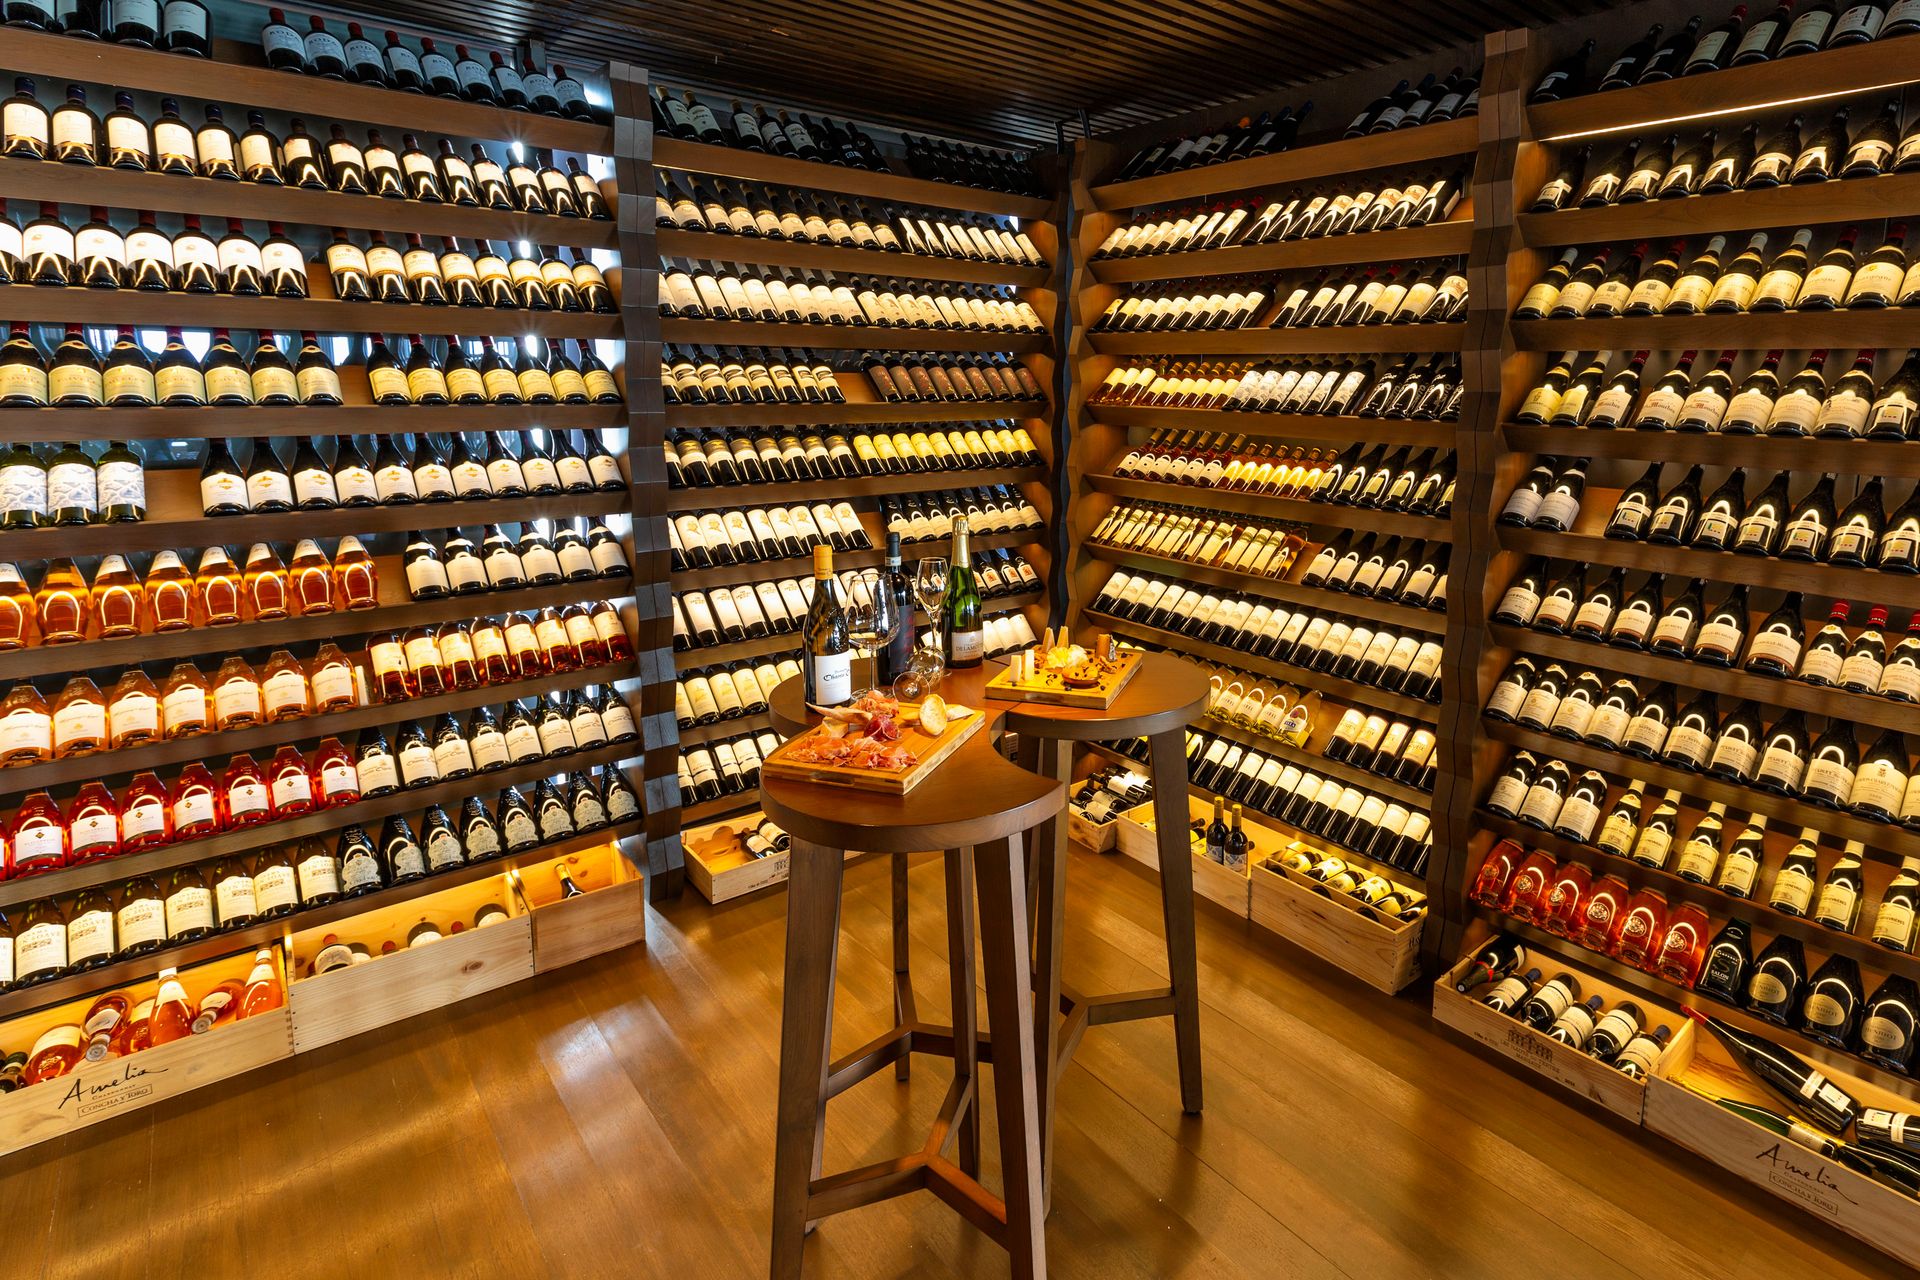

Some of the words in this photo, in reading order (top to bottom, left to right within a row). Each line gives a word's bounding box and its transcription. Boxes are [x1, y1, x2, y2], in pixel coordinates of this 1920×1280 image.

[1711, 969, 1730, 980] SALON
[58, 1062, 169, 1109] Amelia
[81, 1097, 119, 1114] CONCHA
[126, 1088, 149, 1099] TORO
[1755, 1143, 1859, 1205] Amelia
